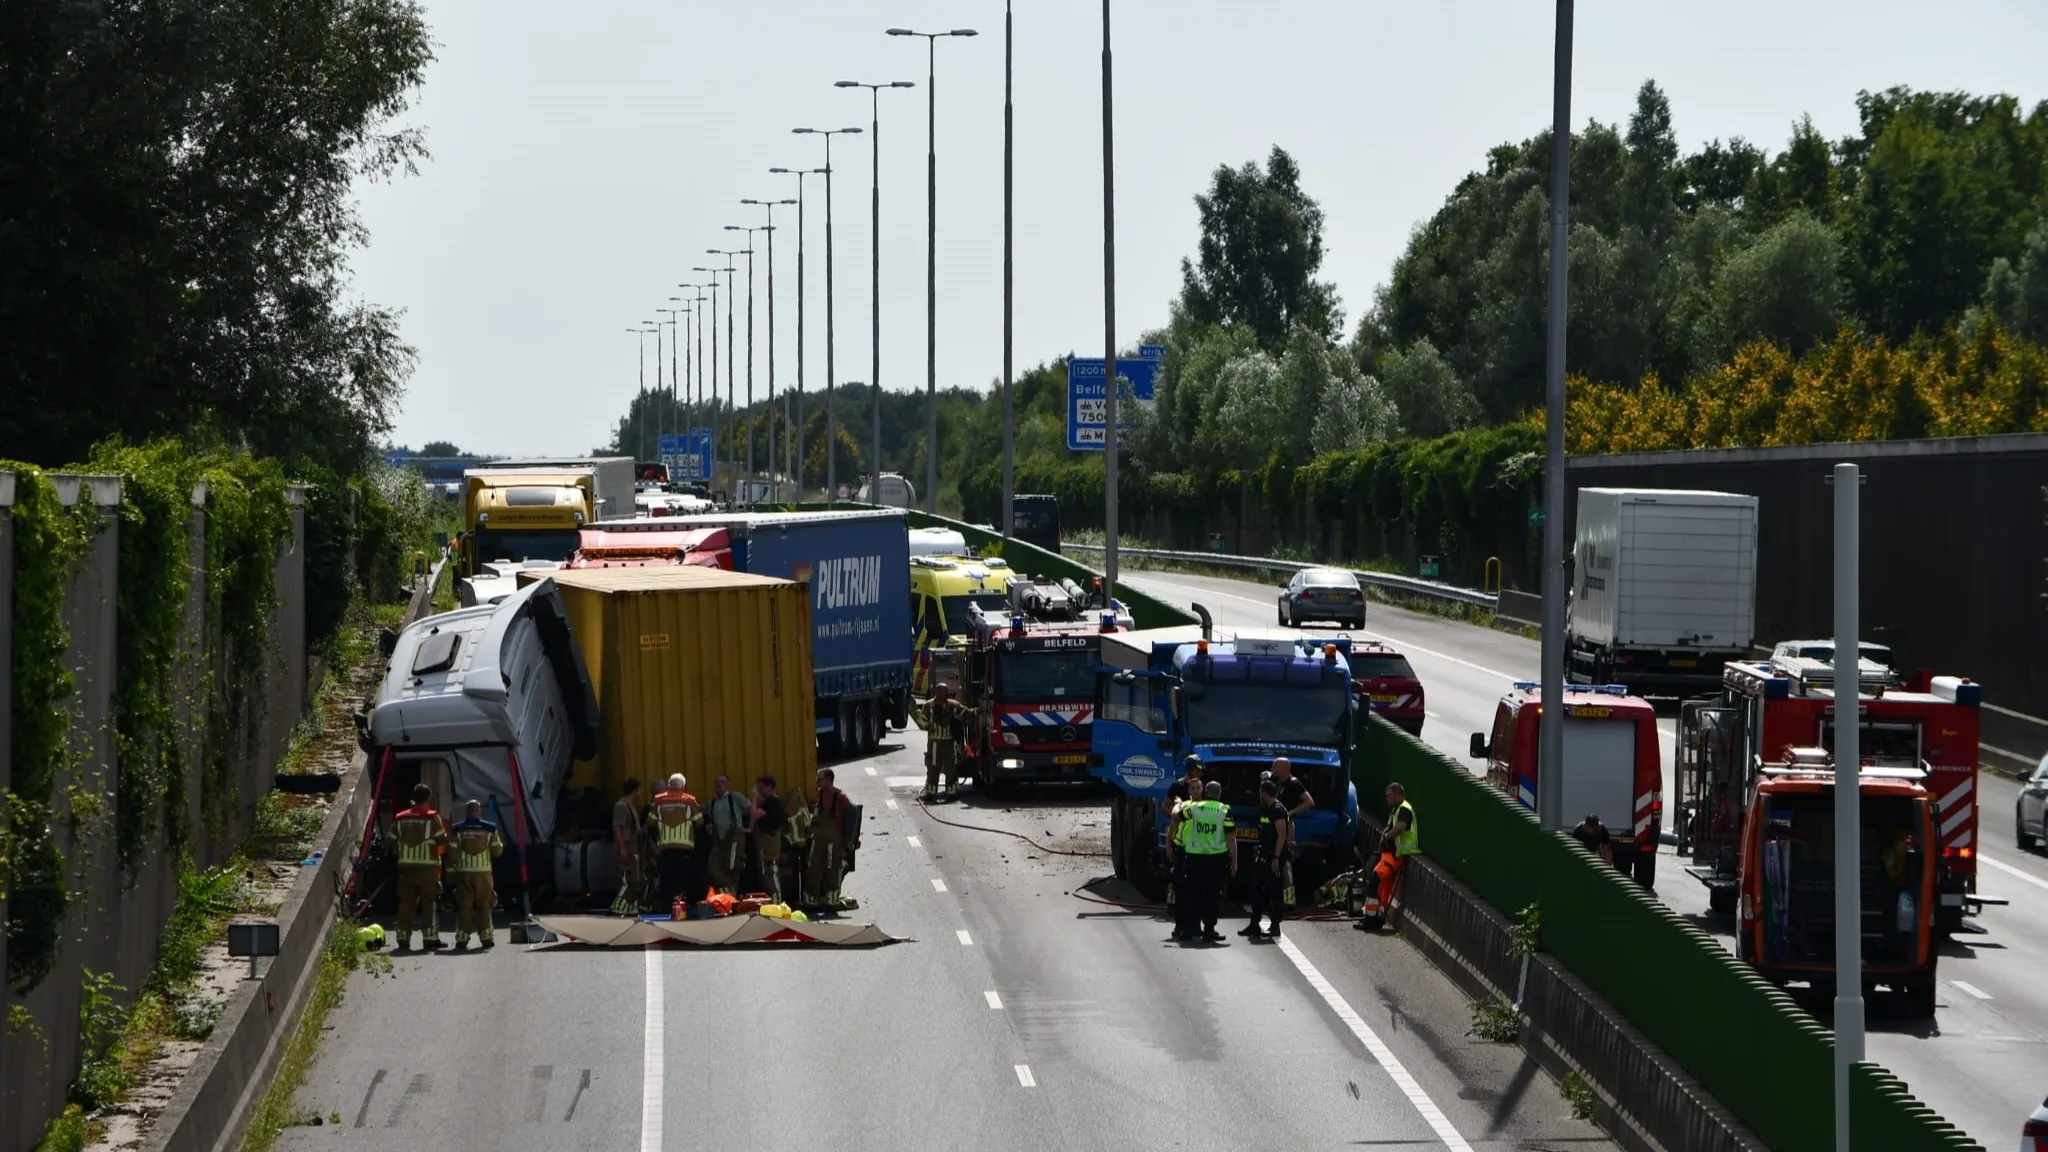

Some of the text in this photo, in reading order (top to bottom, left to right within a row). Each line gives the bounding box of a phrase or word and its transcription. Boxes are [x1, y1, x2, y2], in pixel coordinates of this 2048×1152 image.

[1077, 367, 1098, 375] 1200
[817, 555, 881, 610] PULTRUM
[1044, 638, 1087, 647] BELFELD
